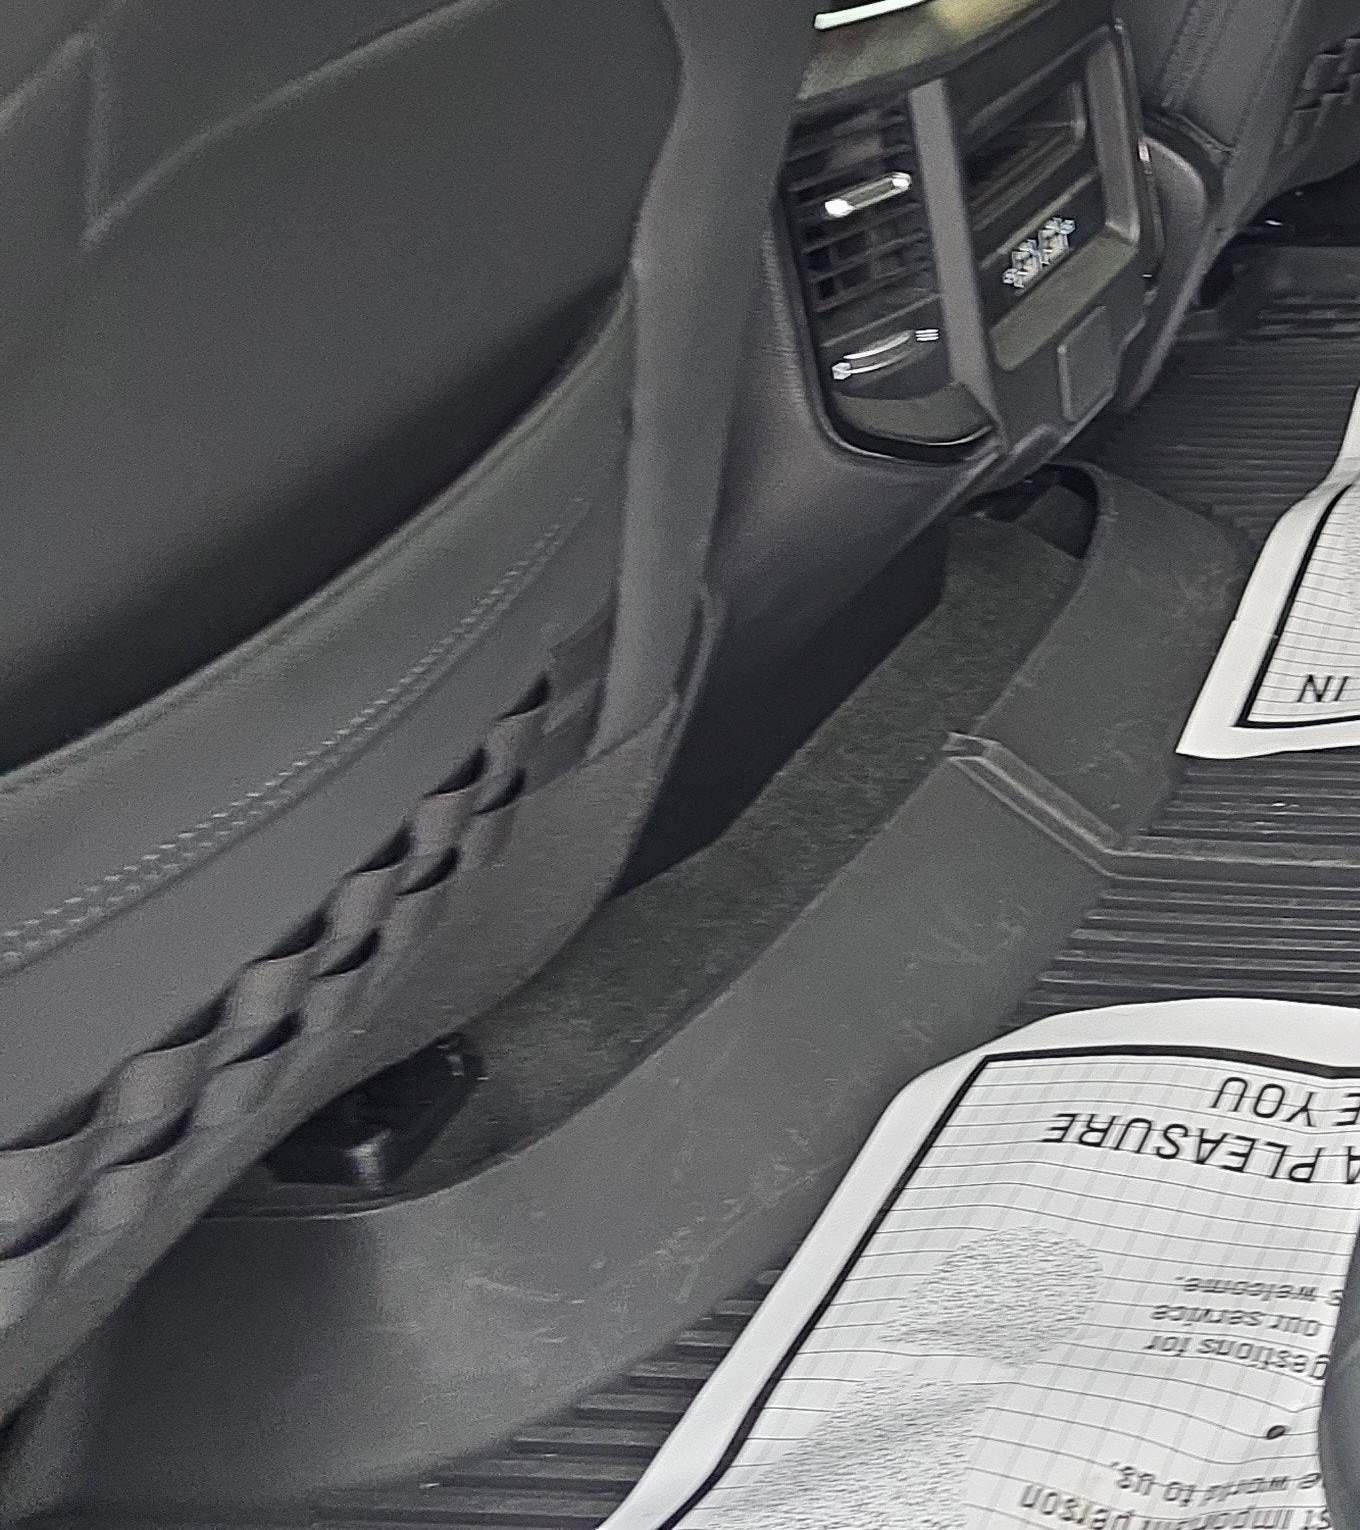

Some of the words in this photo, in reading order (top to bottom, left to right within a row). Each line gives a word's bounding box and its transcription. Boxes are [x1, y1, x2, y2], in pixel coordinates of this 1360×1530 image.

[1297, 674, 1349, 703] IN
[1207, 1077, 1317, 1127] YOU
[1039, 1113, 1323, 1183] PLEASURE
[1148, 1305, 1265, 1328] service
[1269, 1315, 1320, 1338] our
[1141, 1334, 1193, 1358] for
[1019, 1485, 1133, 1530] person
[1163, 1482, 1197, 1508] to
